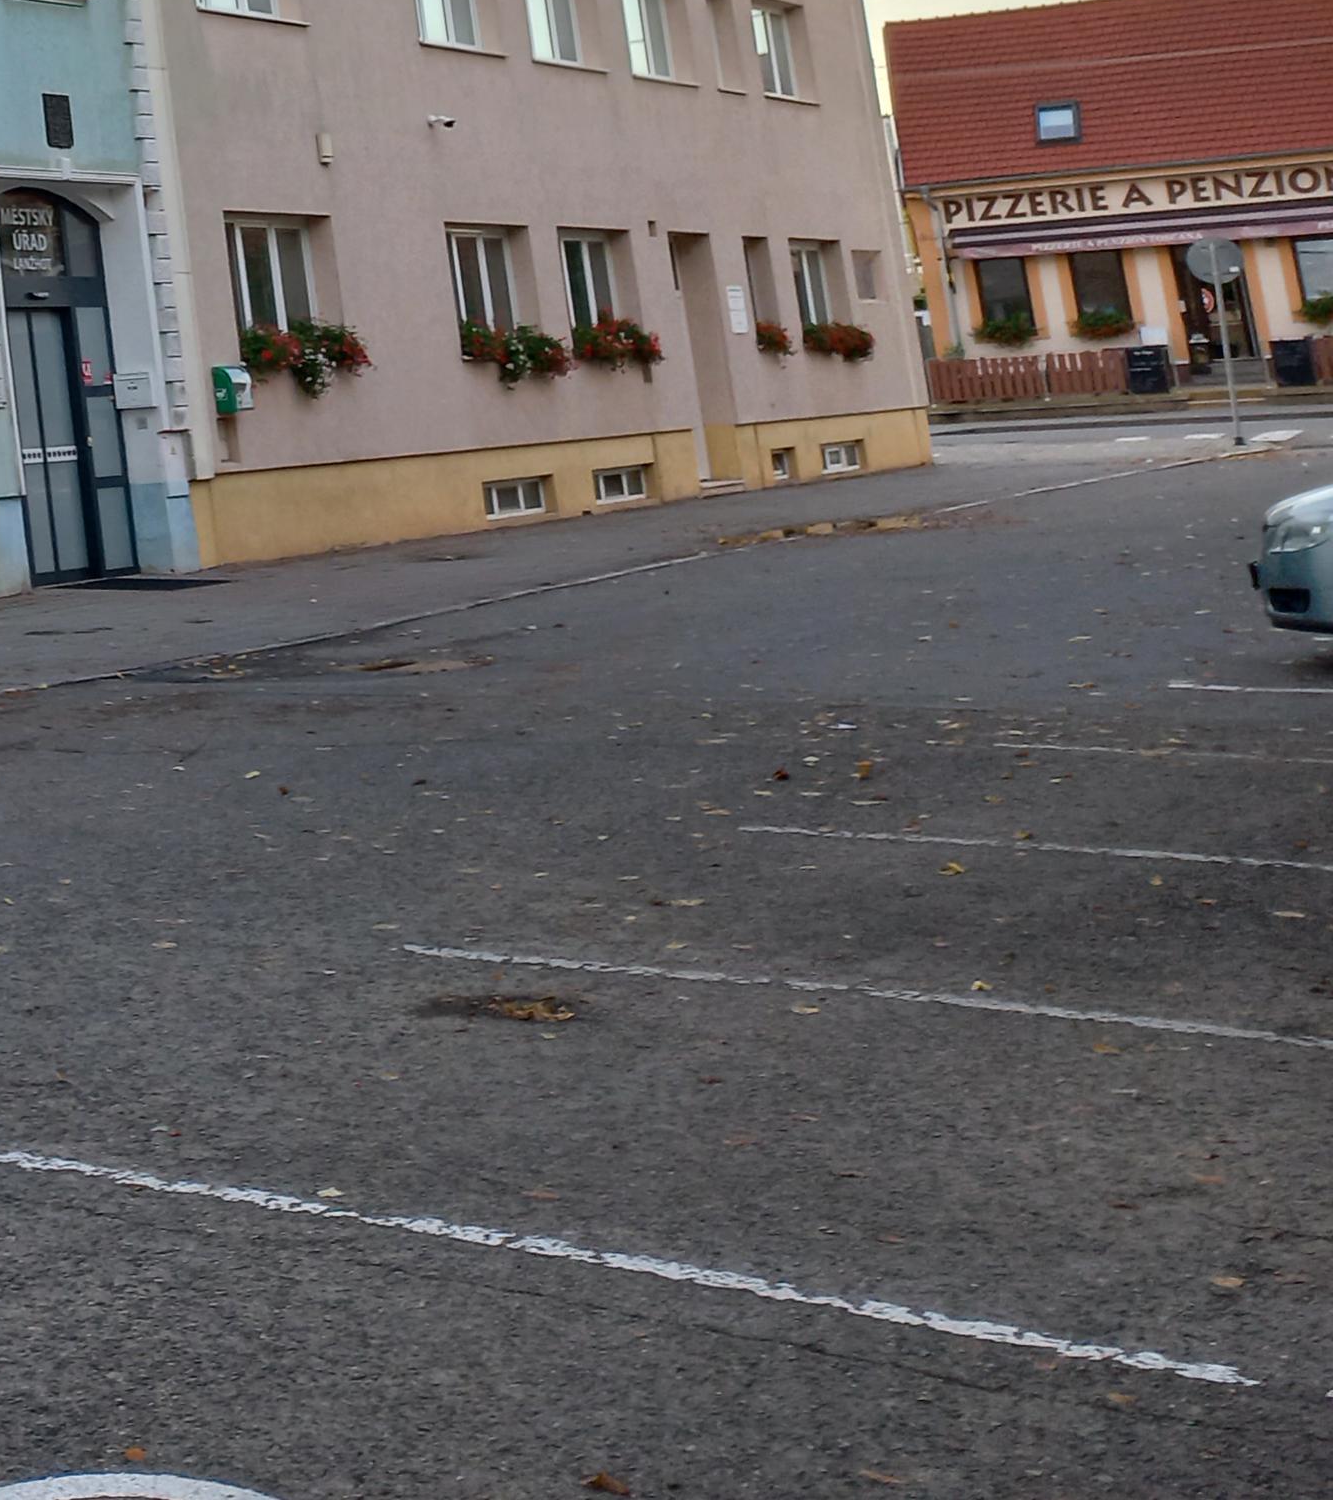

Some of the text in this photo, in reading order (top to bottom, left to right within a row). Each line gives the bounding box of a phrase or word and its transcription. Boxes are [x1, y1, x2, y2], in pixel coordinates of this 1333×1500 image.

[942, 185, 1109, 224] PIZZERIE
[1121, 180, 1154, 208] A
[12, 229, 47, 251] ÚŘAD
